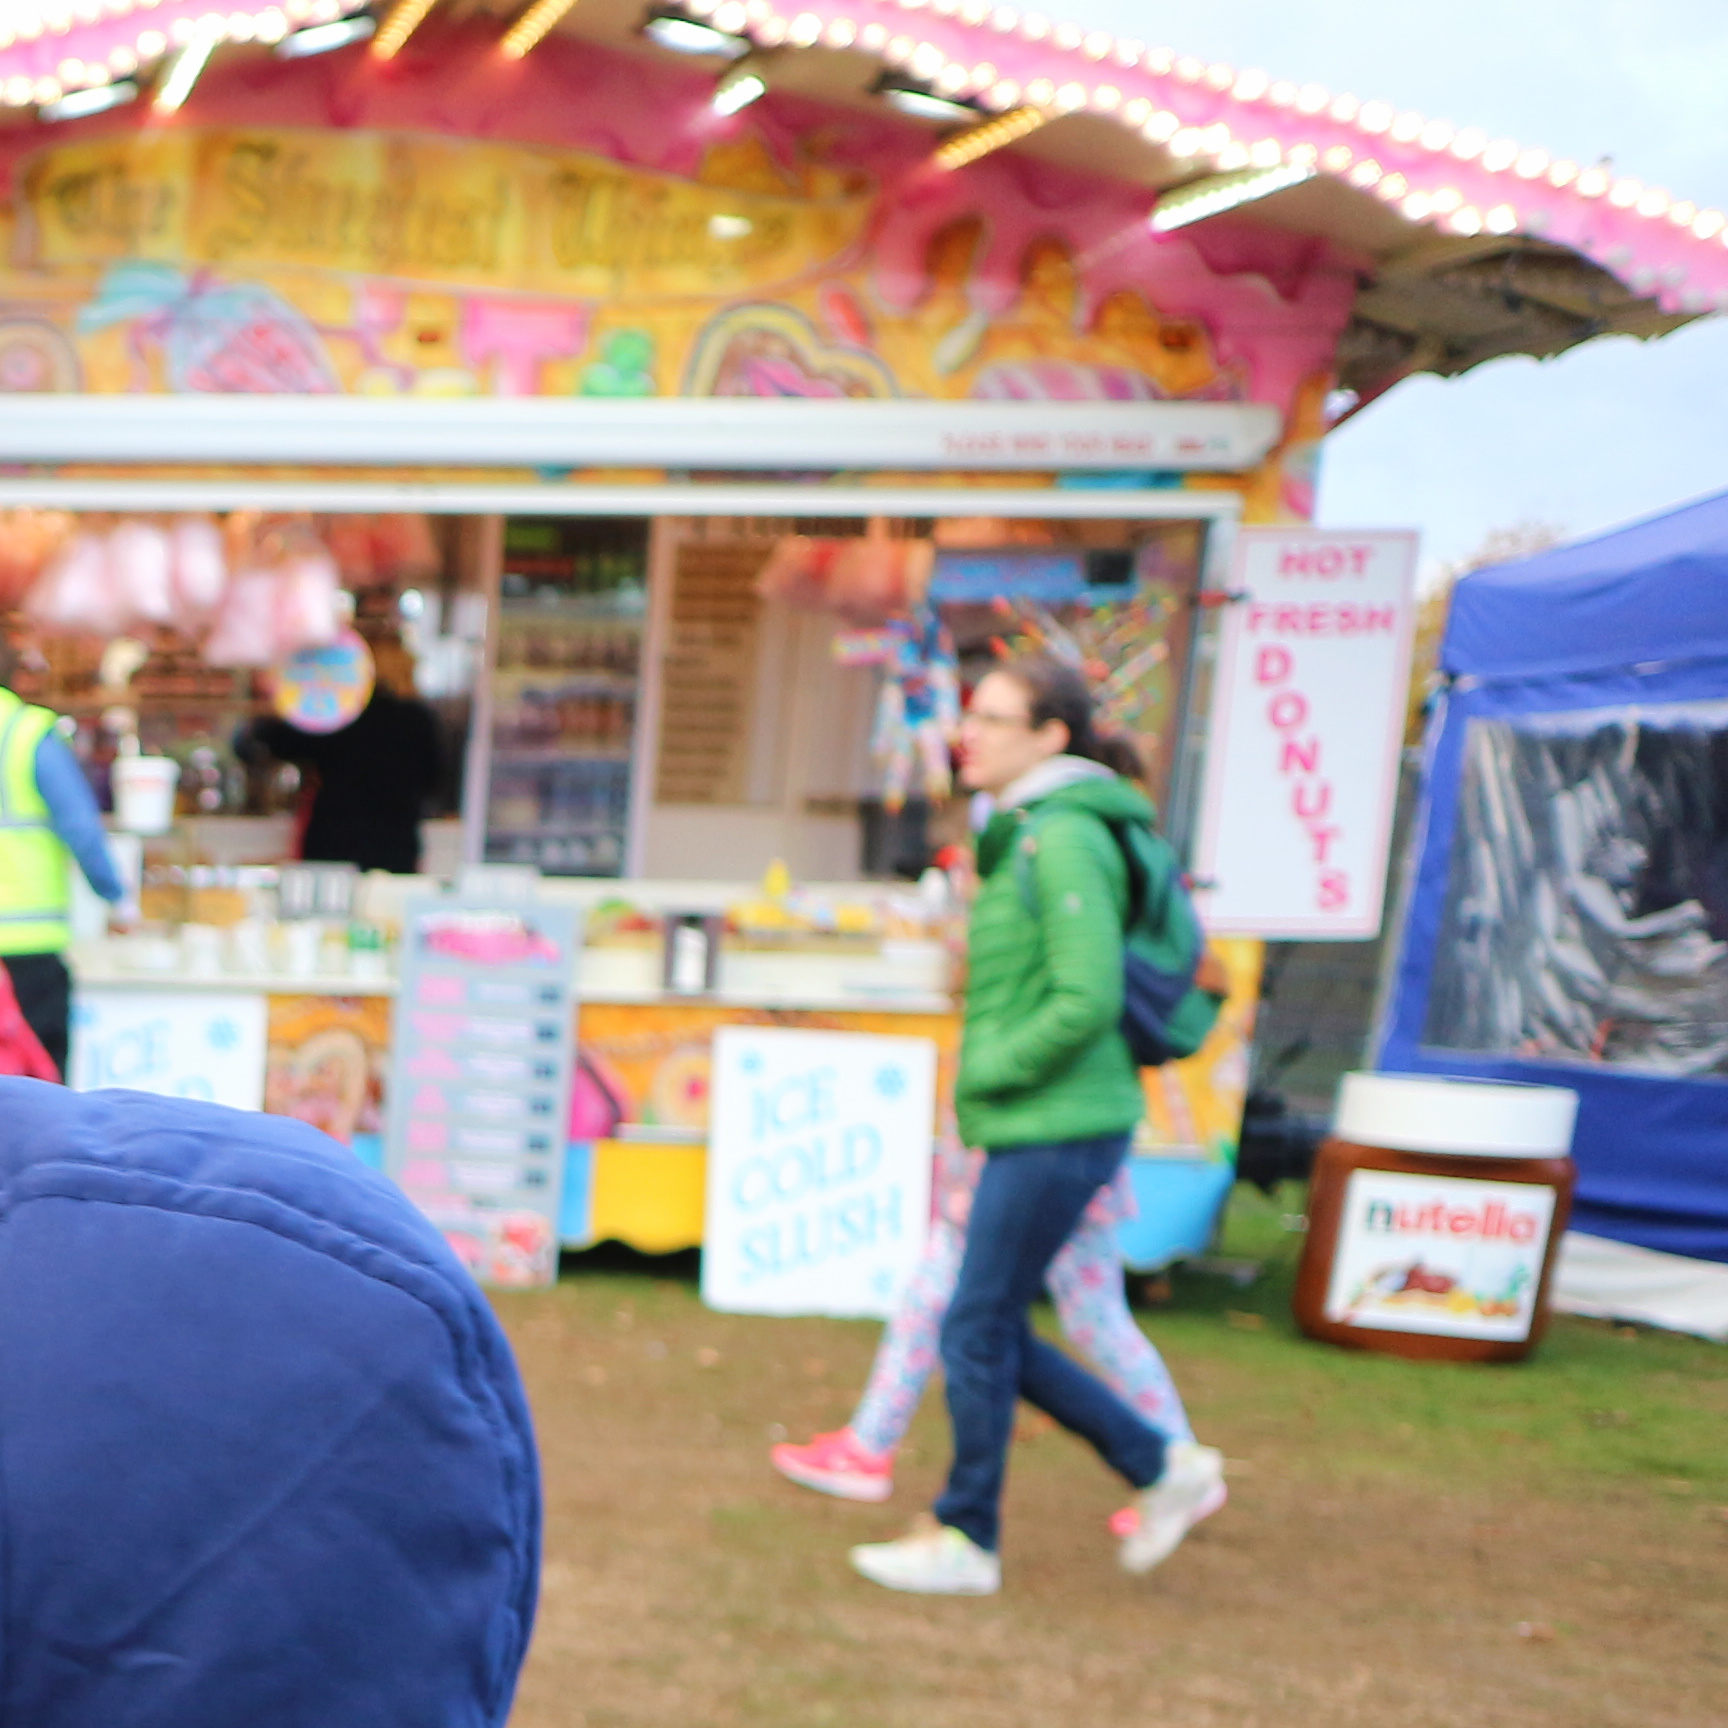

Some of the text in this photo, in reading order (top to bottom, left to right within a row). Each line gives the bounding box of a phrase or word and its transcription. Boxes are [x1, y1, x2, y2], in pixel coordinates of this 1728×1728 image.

[1278, 545, 1374, 577] HOT
[1246, 601, 1396, 635] FRESH
[1254, 643, 1349, 911] DONUTS
[751, 1065, 838, 1142] ICE
[731, 1121, 884, 1214] COLD
[738, 1184, 903, 1287] SLUSH
[1366, 1198, 1537, 1242] nutella
